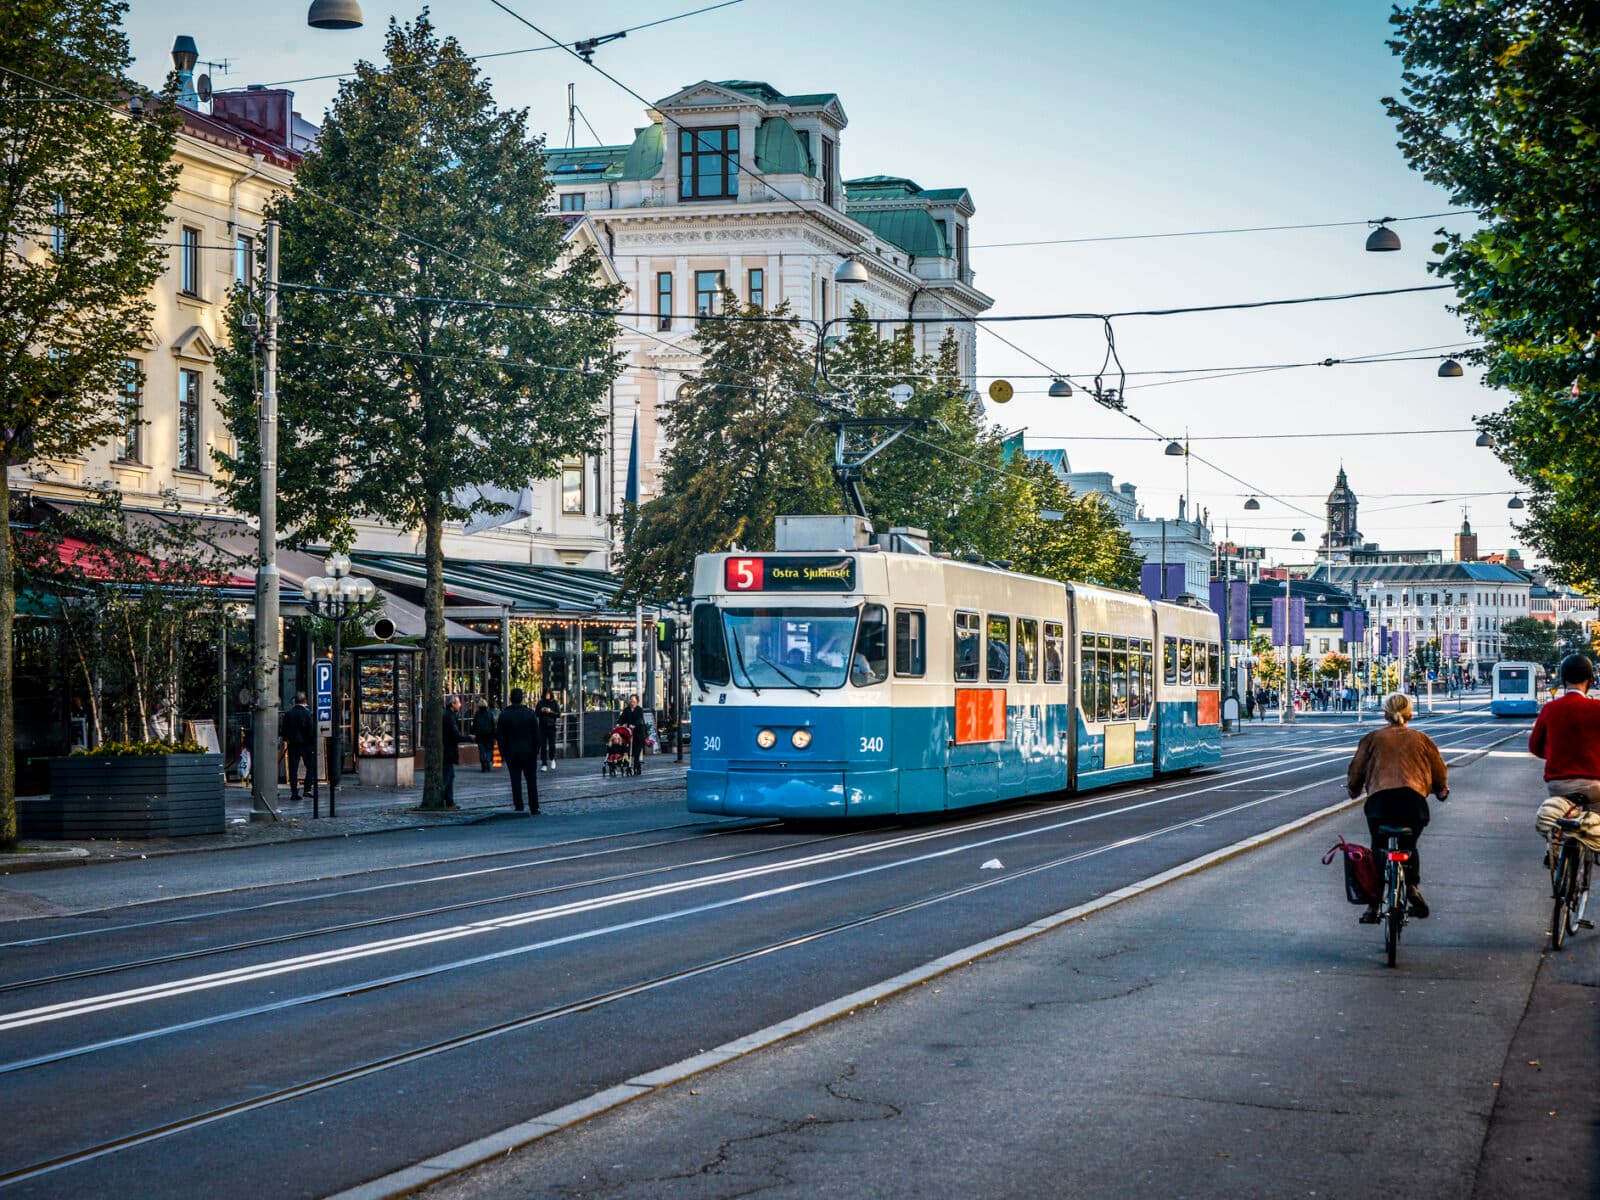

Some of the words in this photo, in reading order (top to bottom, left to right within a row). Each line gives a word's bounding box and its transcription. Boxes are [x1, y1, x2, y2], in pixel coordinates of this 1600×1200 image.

[737, 560, 754, 588] 5
[320, 667, 330, 690] P
[703, 735, 721, 751] 340
[859, 736, 884, 752] 340
